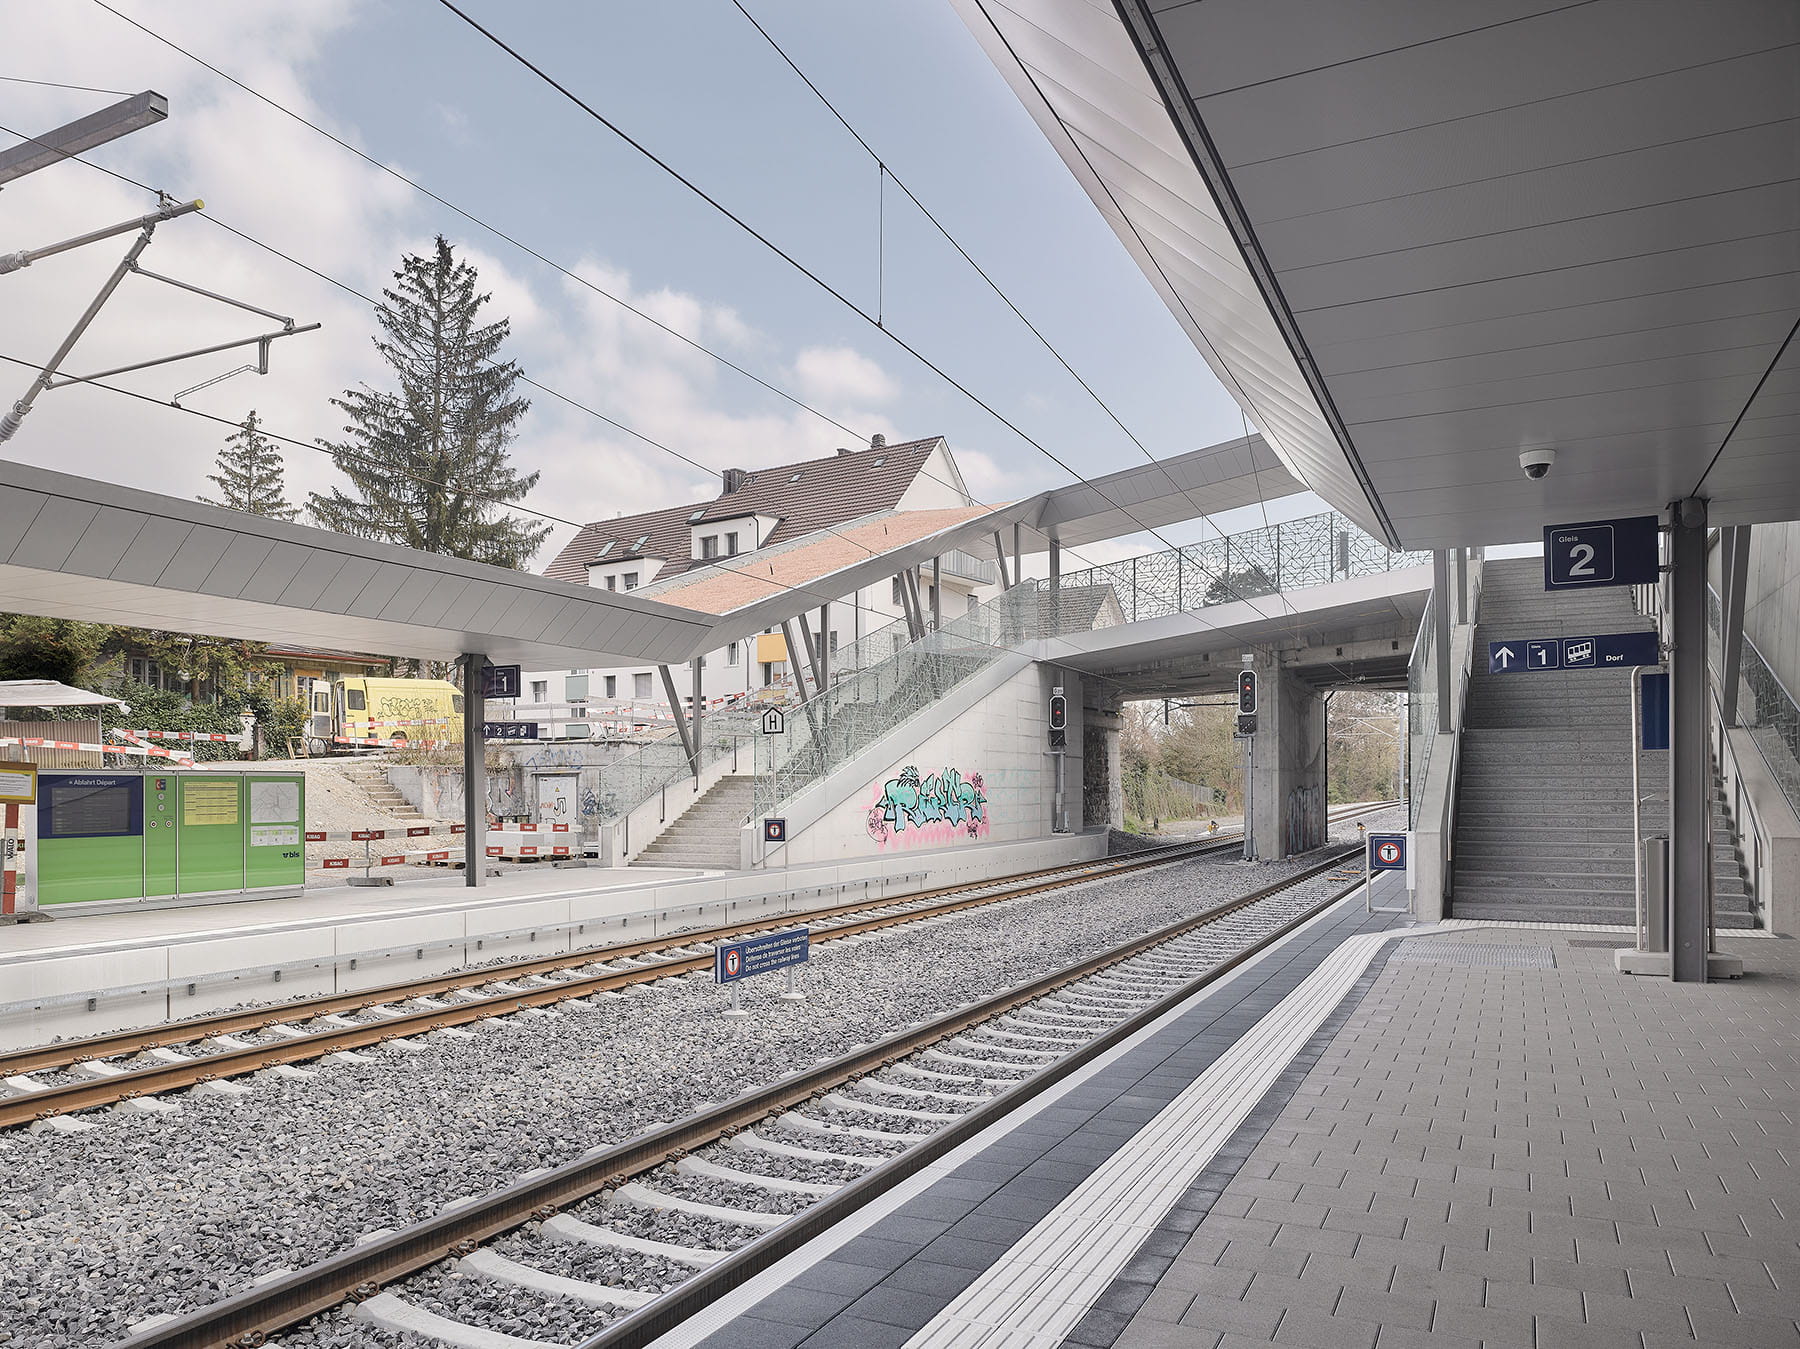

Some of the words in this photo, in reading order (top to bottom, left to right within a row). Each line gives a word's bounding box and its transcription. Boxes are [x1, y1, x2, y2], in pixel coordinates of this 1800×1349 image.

[1569, 544, 1595, 576] 2
[1537, 649, 1546, 665] 1
[1606, 654, 1624, 662] Dorf
[502, 676, 507, 692] 1
[769, 714, 777, 730] H
[496, 728, 502, 736] 2
